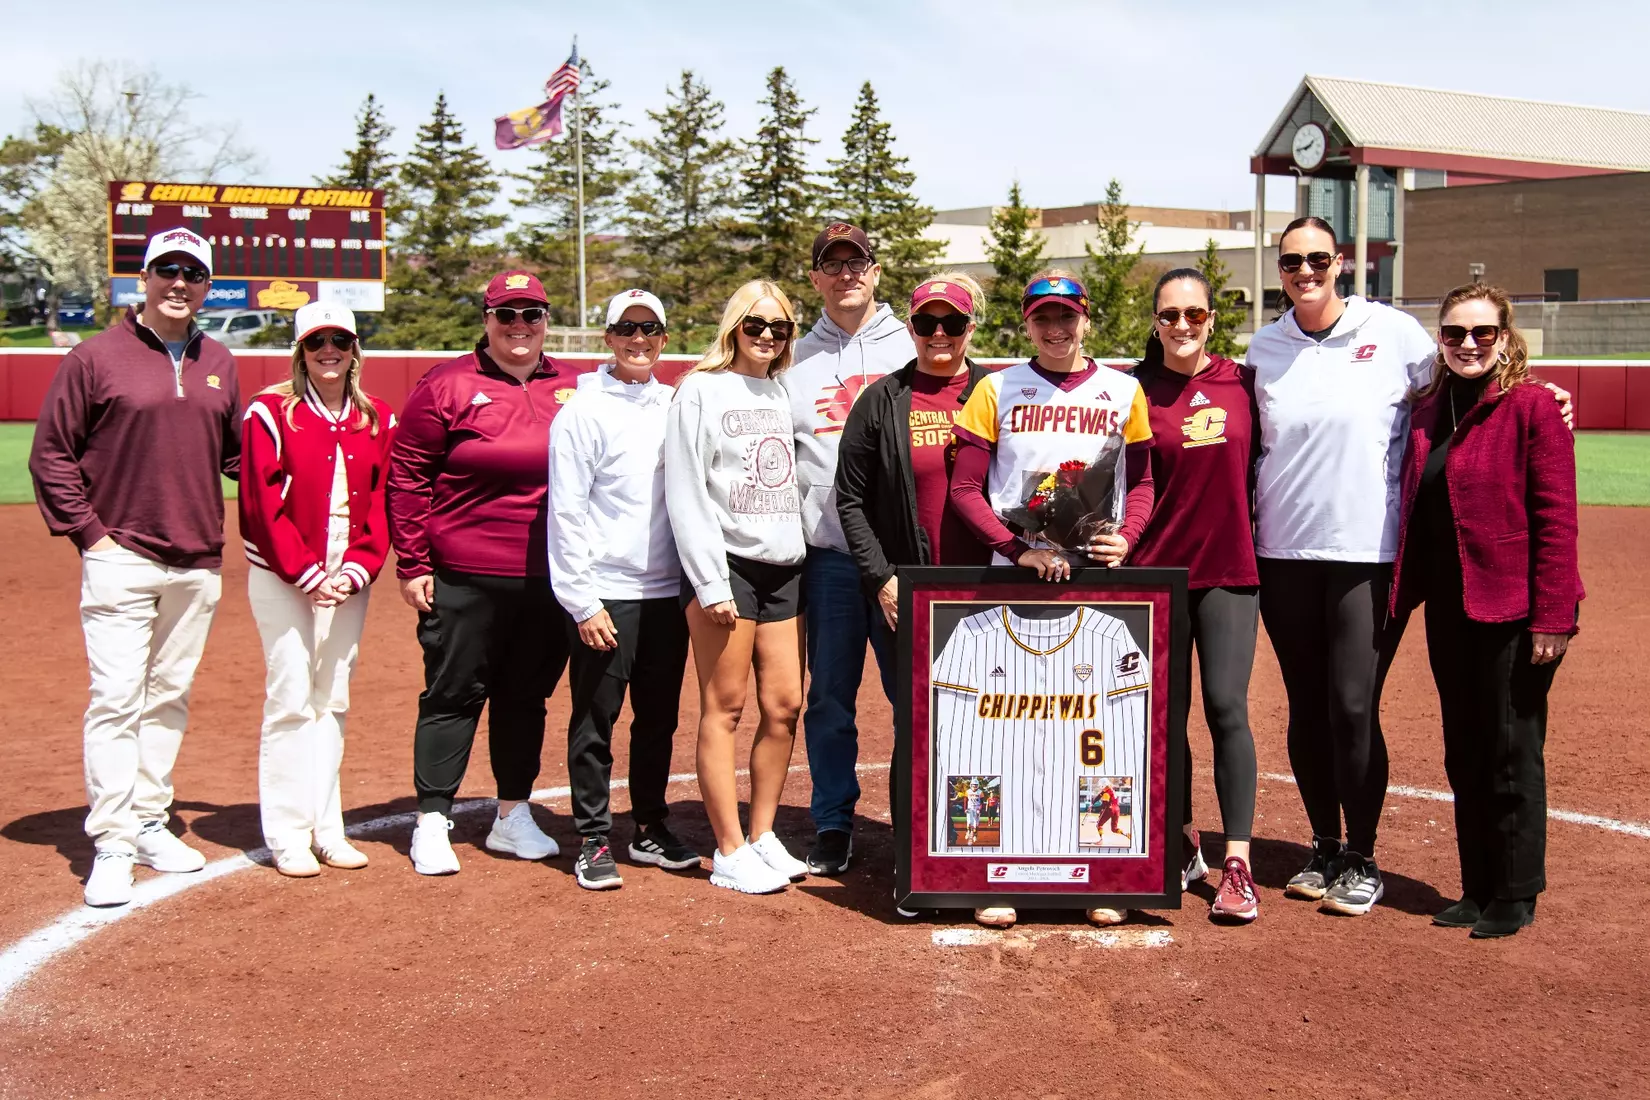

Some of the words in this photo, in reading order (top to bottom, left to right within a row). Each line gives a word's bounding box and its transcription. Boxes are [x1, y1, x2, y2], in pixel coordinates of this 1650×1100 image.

[148, 185, 218, 202] CENTRAL
[219, 186, 300, 205] MICHIGAN
[300, 189, 374, 207] SOFTBALL
[115, 203, 131, 215] AT
[131, 204, 155, 216] BAT
[182, 204, 212, 217] BALL
[229, 206, 269, 220] STRIKE
[288, 207, 312, 221] OUT
[252, 236, 260, 247] 7
[293, 237, 306, 249] 10
[310, 237, 336, 249] RUNS
[341, 238, 362, 250] HITS
[207, 287, 246, 301] pepsi
[908, 410, 951, 427] CENTRAL
[1010, 404, 1119, 436] CHIPPEWAS
[978, 693, 1099, 720] CHIPPEWAS
[1080, 728, 1105, 768] 6
